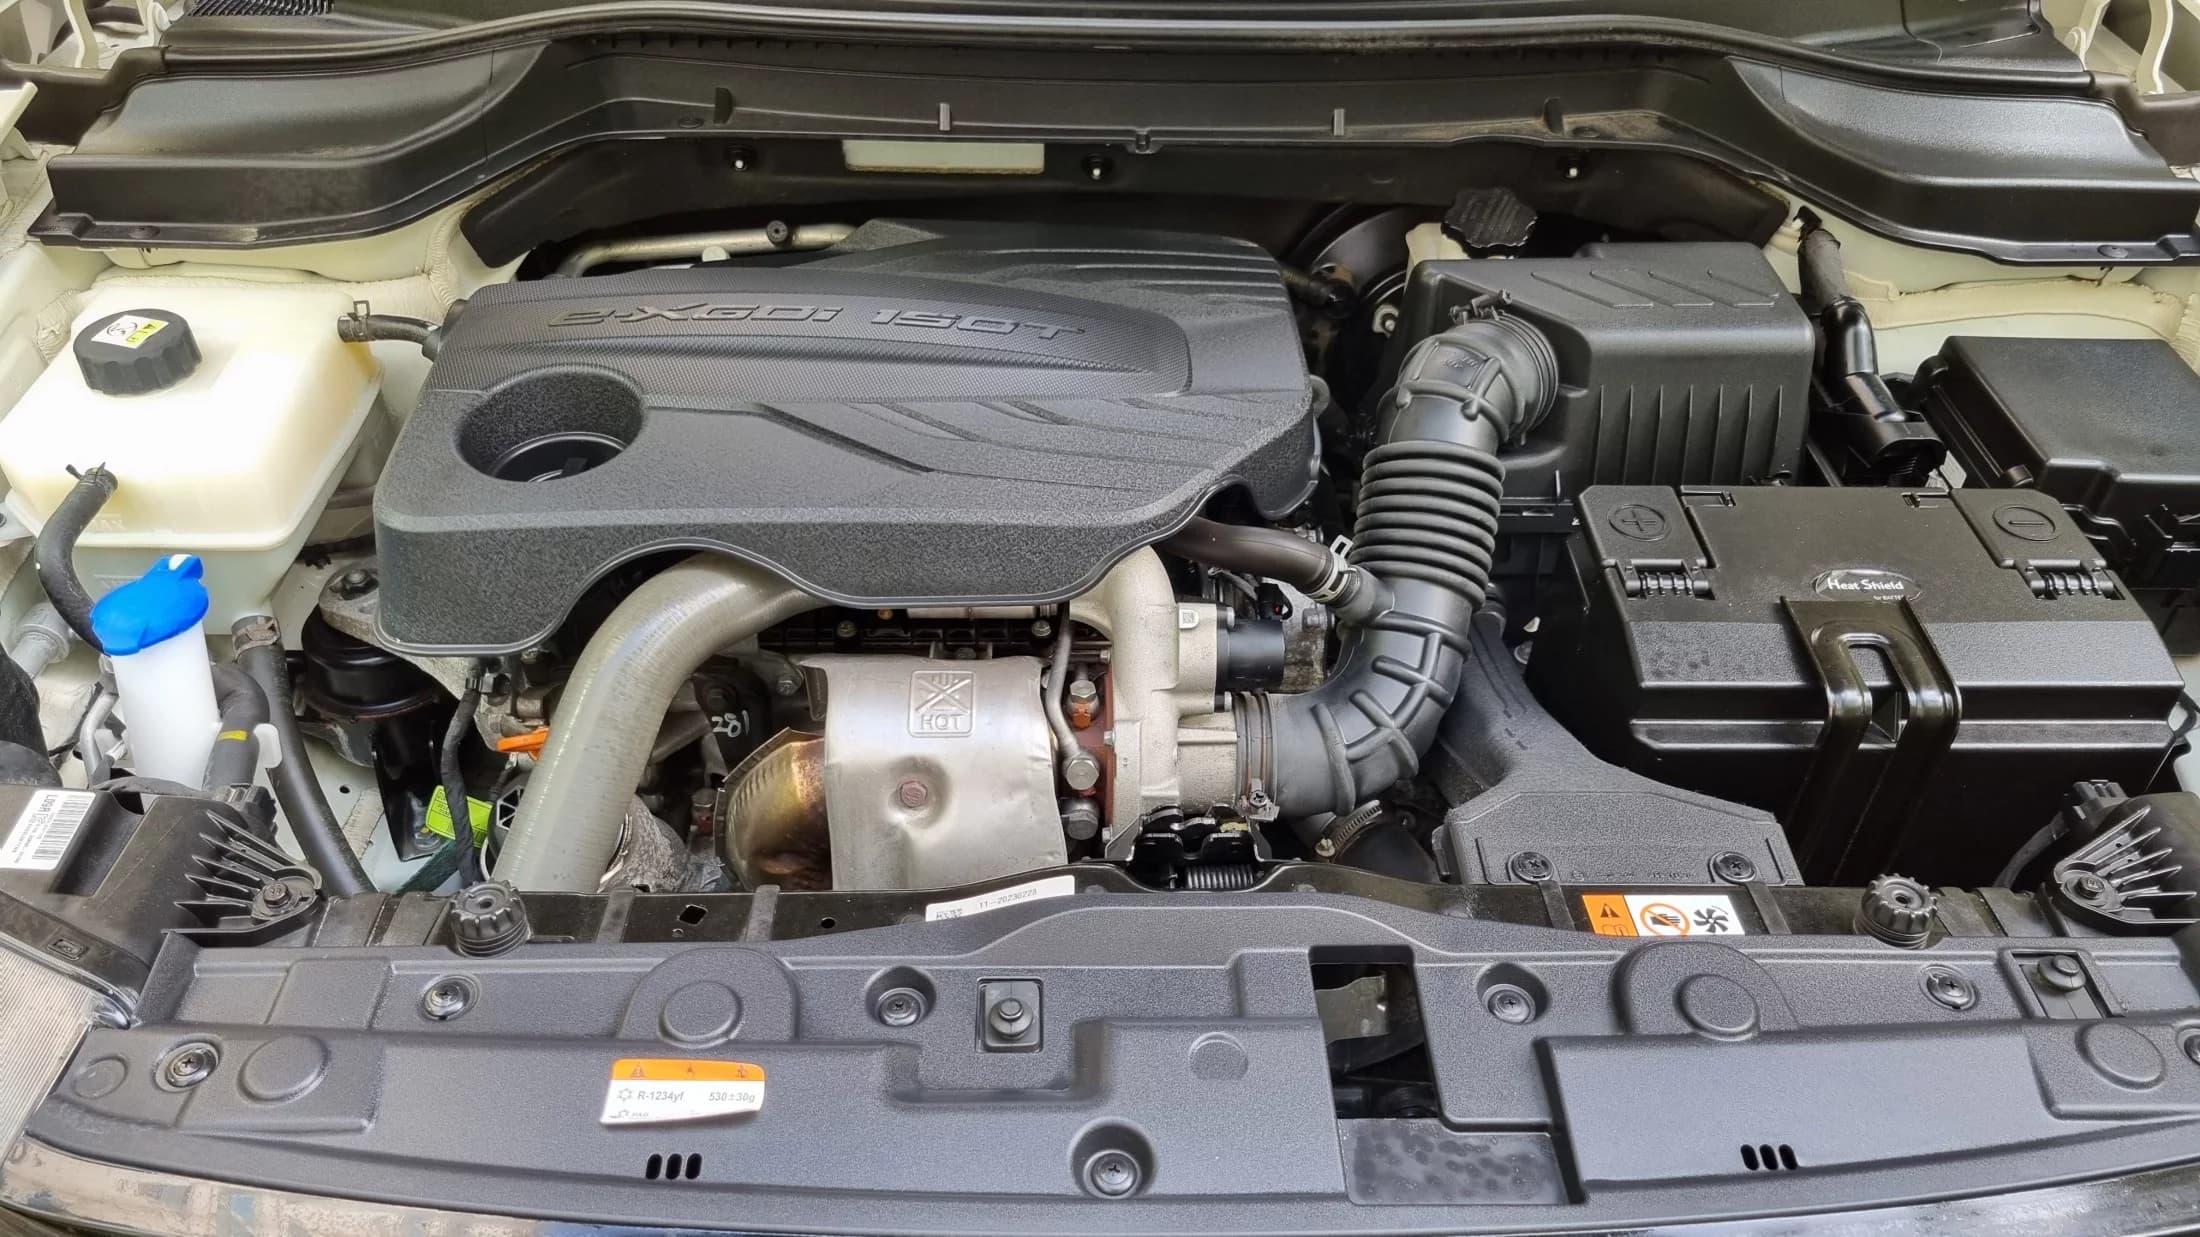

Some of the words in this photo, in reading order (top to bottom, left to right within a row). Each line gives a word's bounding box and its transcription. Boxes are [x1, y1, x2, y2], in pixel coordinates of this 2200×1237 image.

[870, 309, 1086, 340] 150T
[1827, 577, 1860, 590] Heat
[1860, 579, 1905, 590] Shield
[711, 709, 750, 738] 281
[920, 713, 964, 730] HOT
[637, 1090, 685, 1103] R-1234yf
